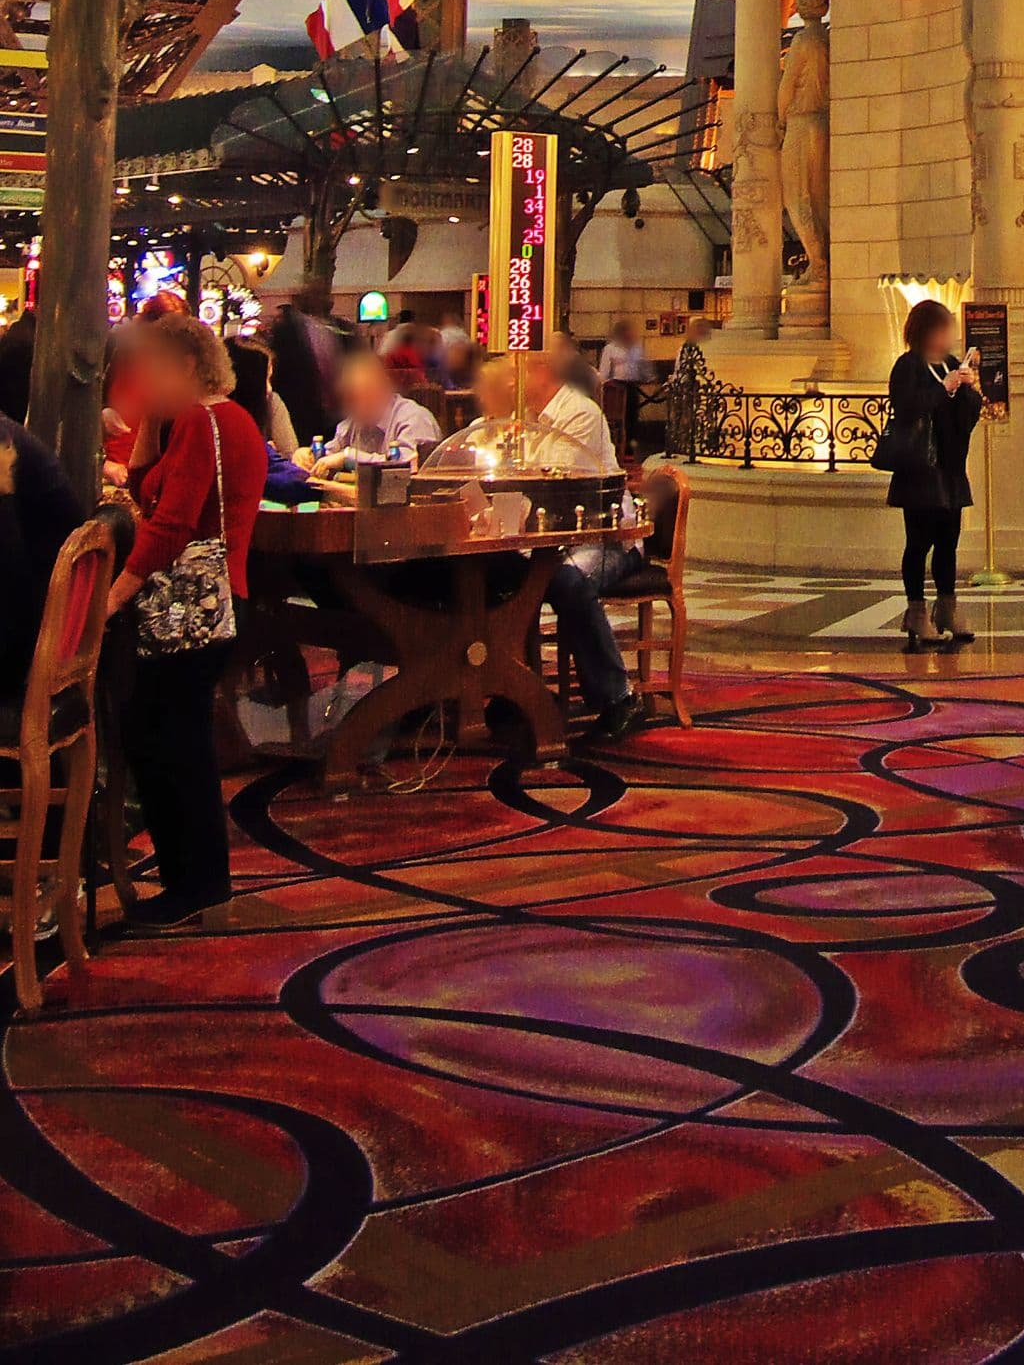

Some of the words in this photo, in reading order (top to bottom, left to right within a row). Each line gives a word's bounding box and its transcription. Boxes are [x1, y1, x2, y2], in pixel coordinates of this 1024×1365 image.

[512, 138, 533, 153] 28
[512, 153, 533, 168] 28
[525, 169, 544, 184] 19
[535, 185, 544, 199] 1
[523, 199, 544, 214] 34
[534, 215, 544, 229] 3
[522, 229, 544, 244] 25
[521, 244, 533, 259] 0
[510, 259, 531, 274] 28
[509, 274, 530, 289] 26
[509, 289, 530, 304] 13
[521, 304, 542, 320] 21
[508, 319, 530, 334] 33
[508, 334, 530, 350] 22
